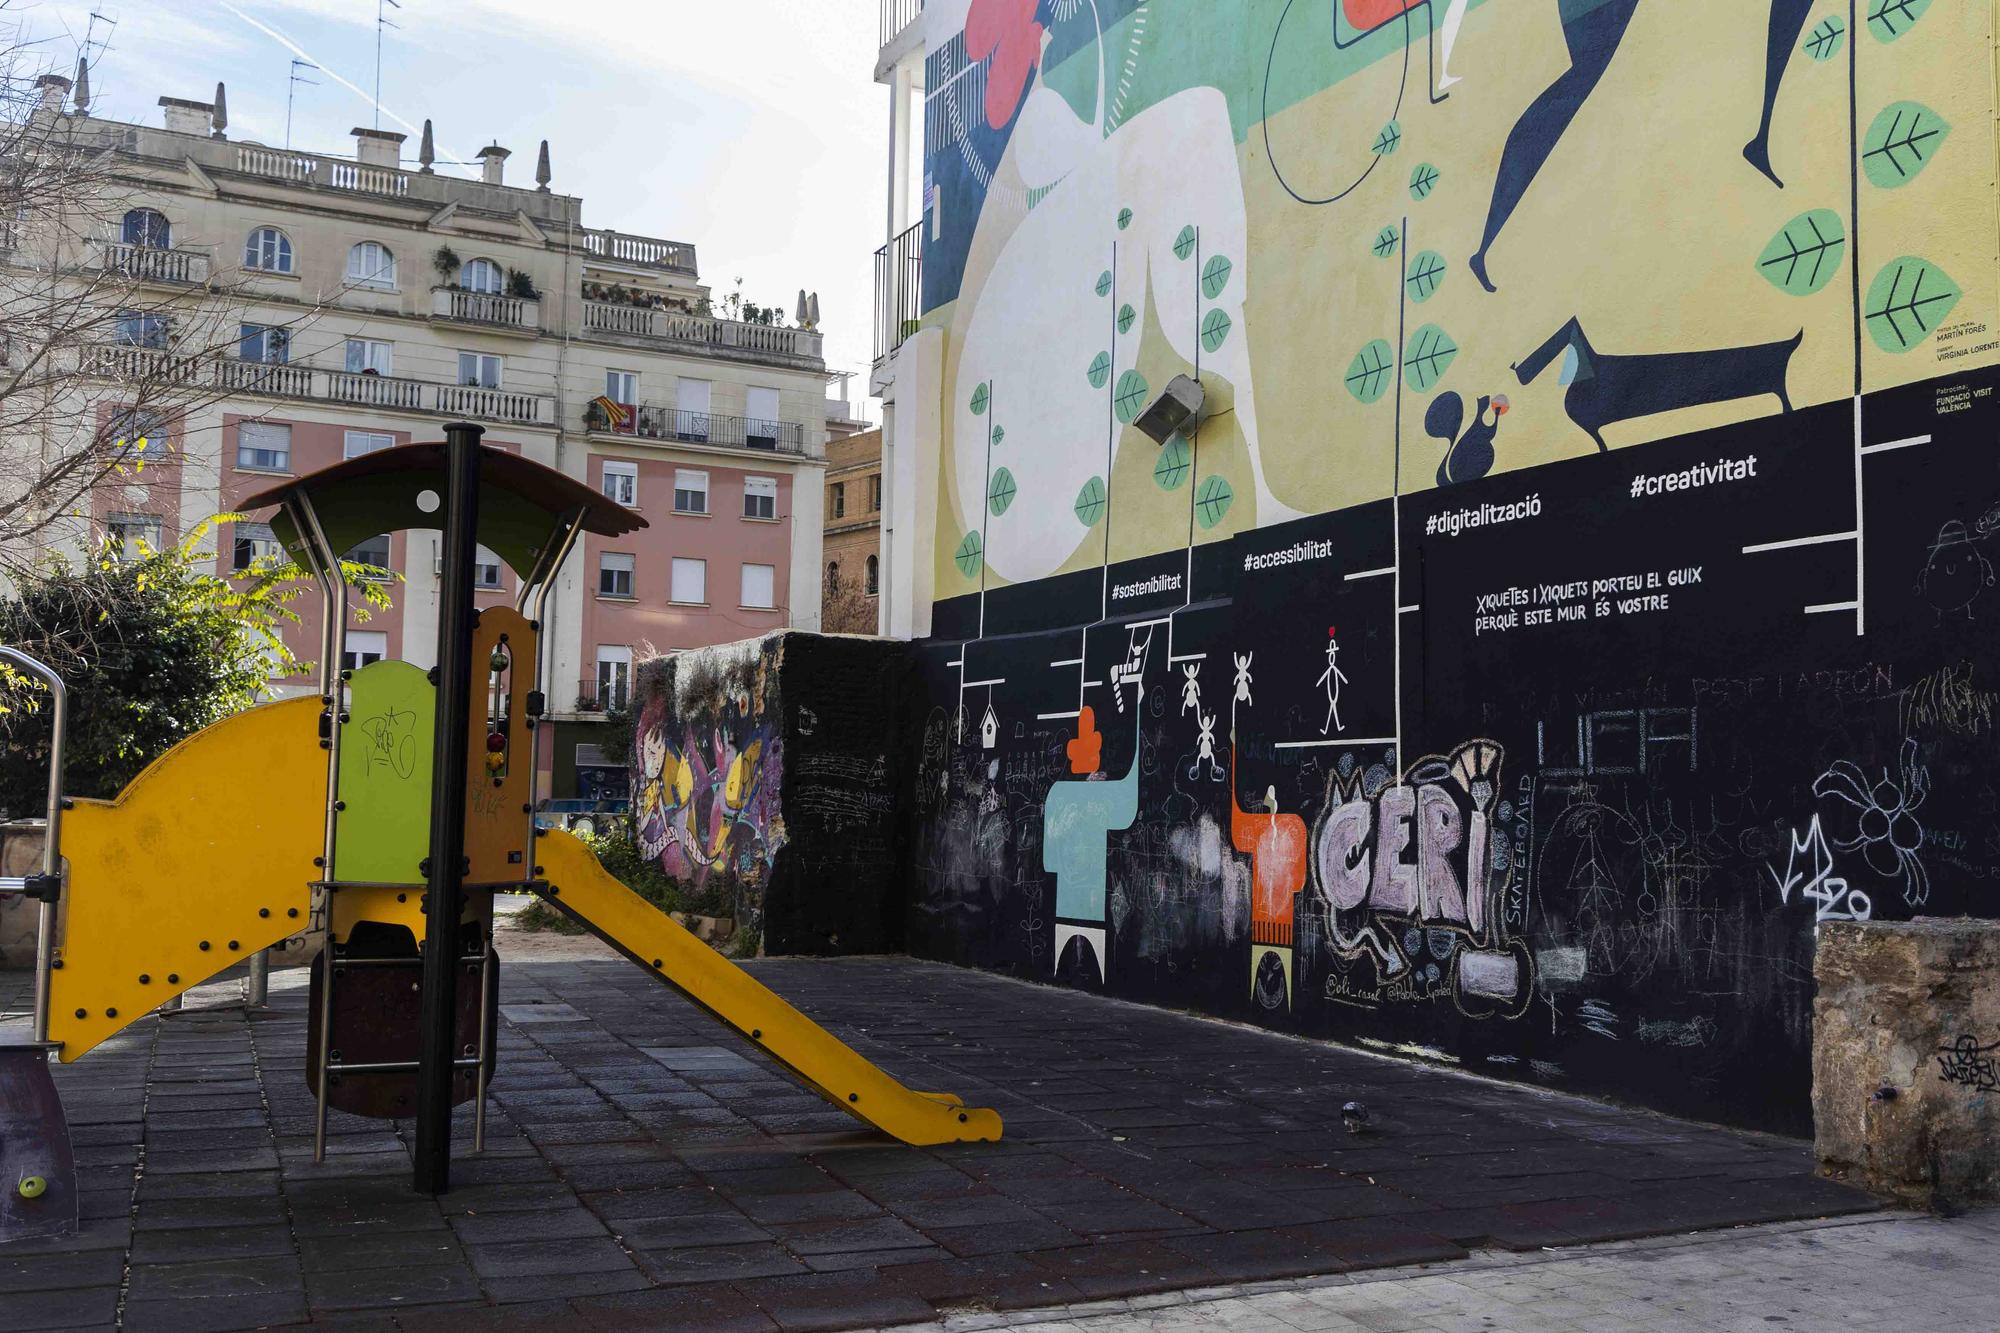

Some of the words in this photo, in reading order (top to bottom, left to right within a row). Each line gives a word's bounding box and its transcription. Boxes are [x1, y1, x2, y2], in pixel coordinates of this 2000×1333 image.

[1937, 330, 1963, 342] MARTÍN
[1965, 323, 1986, 335] FORÉS
[1937, 348, 1968, 362] VIRGINIA
[1970, 342, 1999, 354] LORENTE
[1936, 389, 1970, 406] FUNDACIÓ
[1973, 387, 1992, 398] VISIT
[1630, 454, 1757, 499] #creativitat
[1425, 493, 1542, 537] #digitalització
[1244, 539, 1333, 571] #accessibilitat
[1112, 573, 1182, 600] #sostenibilitat
[1476, 587, 1529, 615] XIQUETES
[1532, 588, 1537, 604] I
[1539, 581, 1589, 606] XIQUETS
[1592, 574, 1643, 600] PORTEU
[1647, 572, 1662, 589] EL
[1667, 566, 1703, 587] GUIX
[1475, 609, 1519, 637] PERQUÈ
[1524, 608, 1553, 626] ESTE
[1557, 605, 1587, 622] MUR
[1595, 596, 1611, 617] ÉS
[1617, 594, 1669, 615] VOSTRE
[1505, 774, 1533, 926] SKATEBOARD
